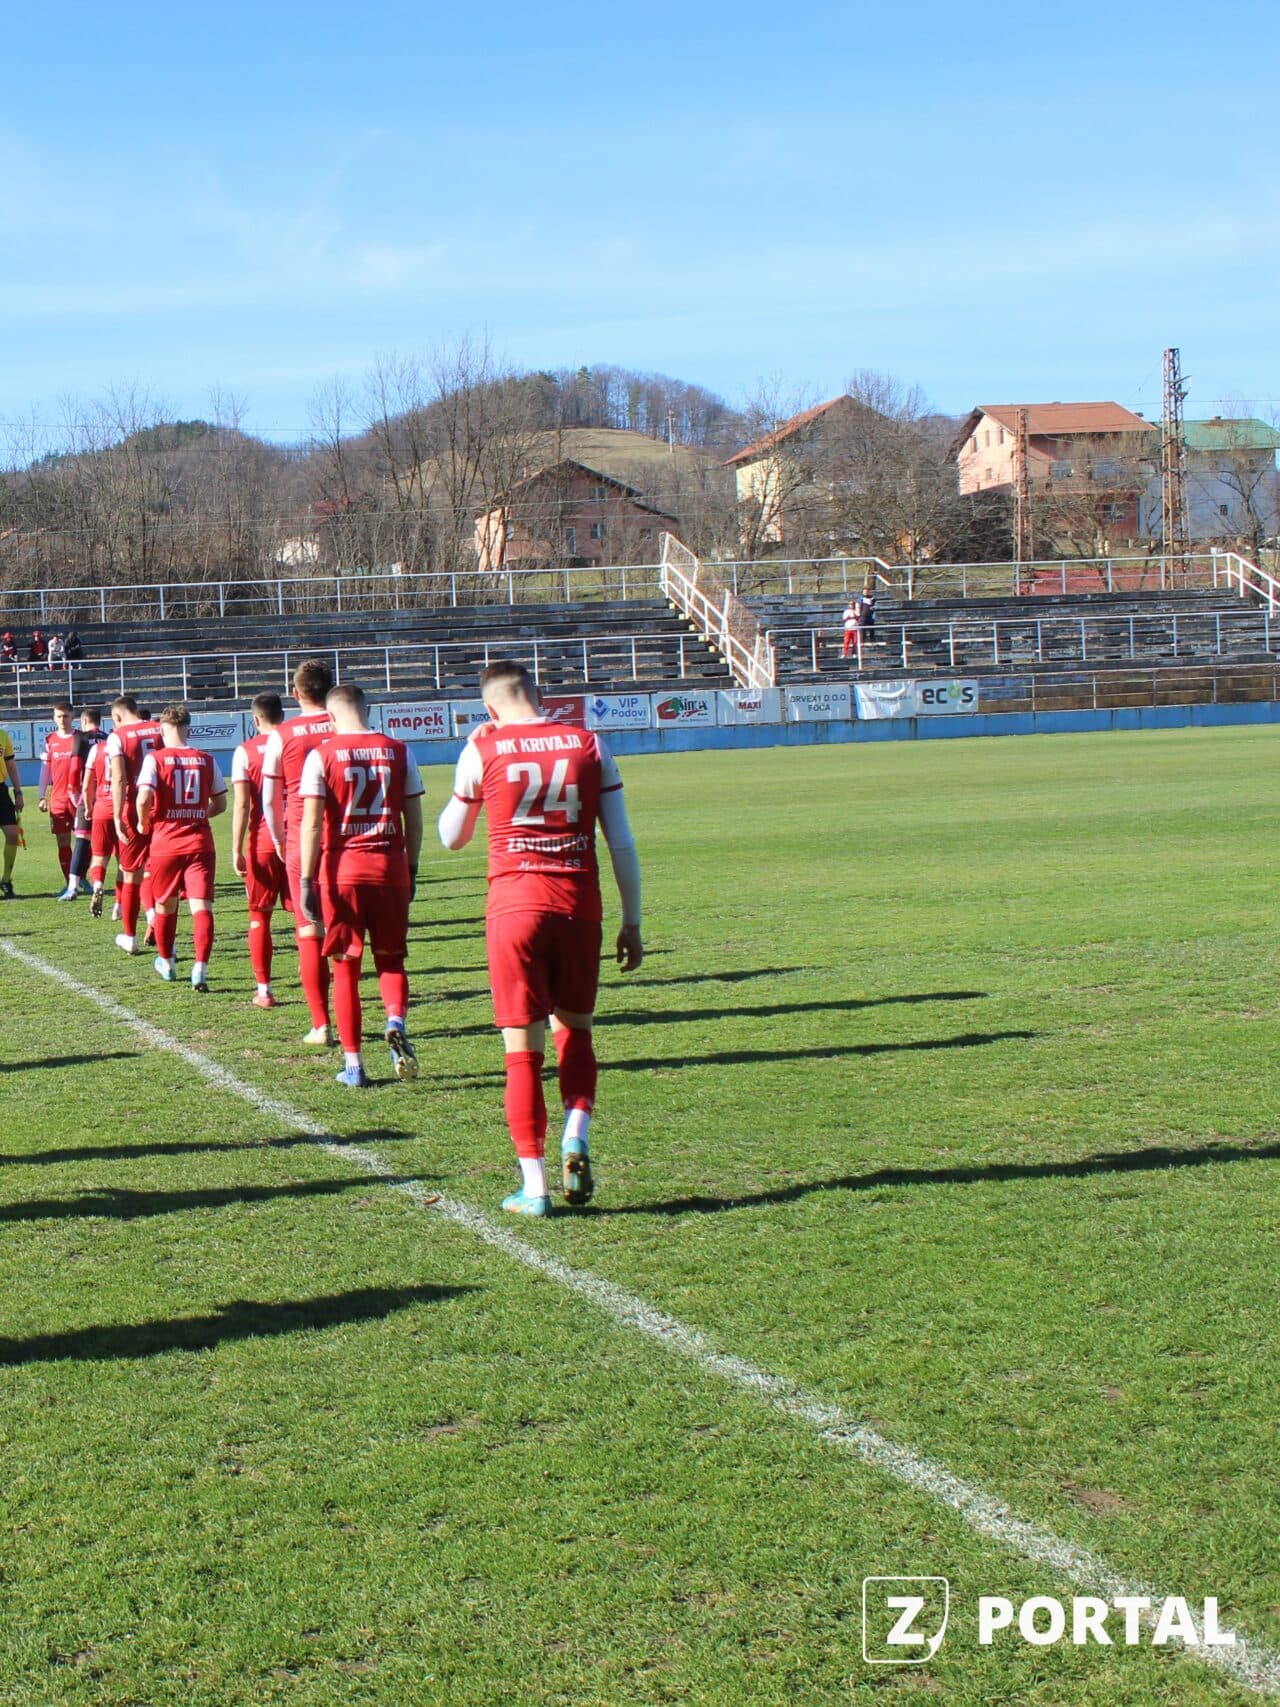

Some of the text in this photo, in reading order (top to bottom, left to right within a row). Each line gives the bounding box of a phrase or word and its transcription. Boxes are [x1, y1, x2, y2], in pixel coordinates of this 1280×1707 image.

[618, 697, 639, 708] VIP
[387, 712, 444, 731] mapek
[611, 708, 646, 718] Podovi
[292, 721, 333, 737] NK KRIV
[495, 734, 583, 755] NK KRIVAJA
[335, 747, 395, 762] NK KRIVAJA
[344, 765, 392, 816] 22
[506, 758, 582, 826] 24
